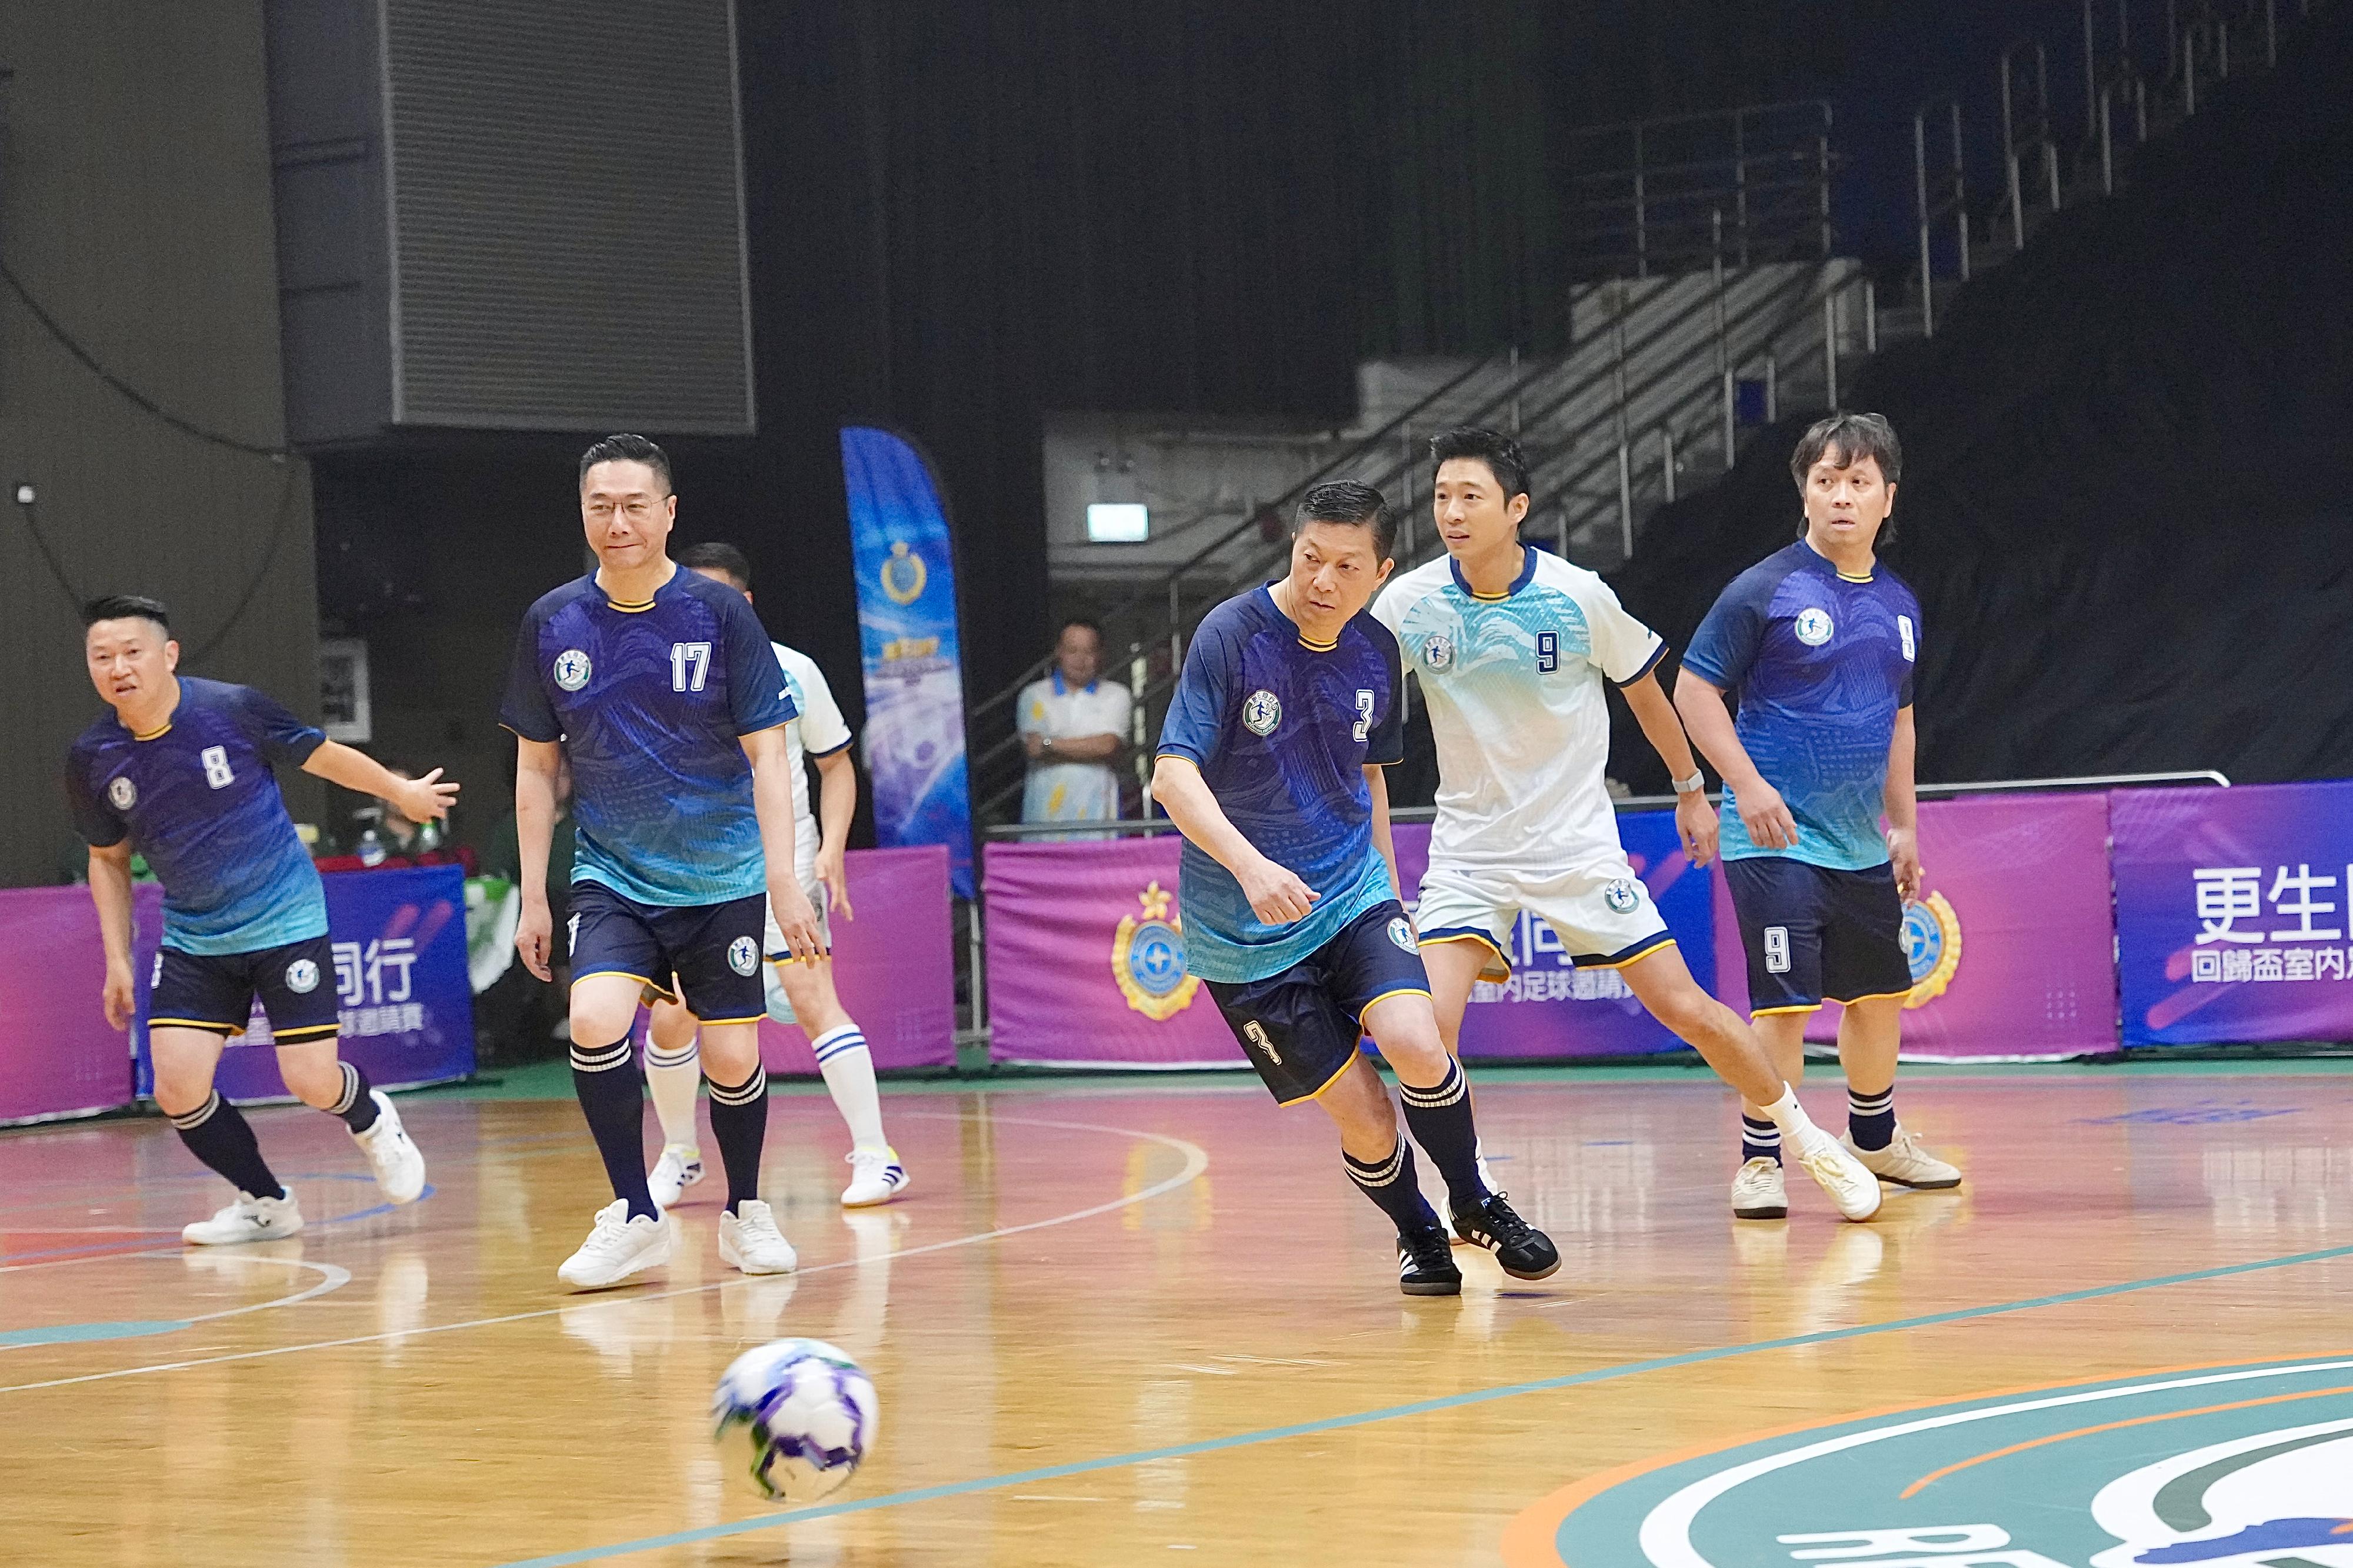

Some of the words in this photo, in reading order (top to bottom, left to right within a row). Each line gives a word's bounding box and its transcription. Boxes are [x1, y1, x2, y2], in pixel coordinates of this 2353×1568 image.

[1535, 630, 1560, 675] 9
[1897, 615, 1915, 663] 9
[670, 642, 711, 692] 17
[1353, 689, 1375, 742] 3
[202, 745, 235, 789] 8
[2192, 863, 2353, 945] 更生
[1764, 926, 1791, 973] 9
[1243, 1020, 1282, 1066] 3
